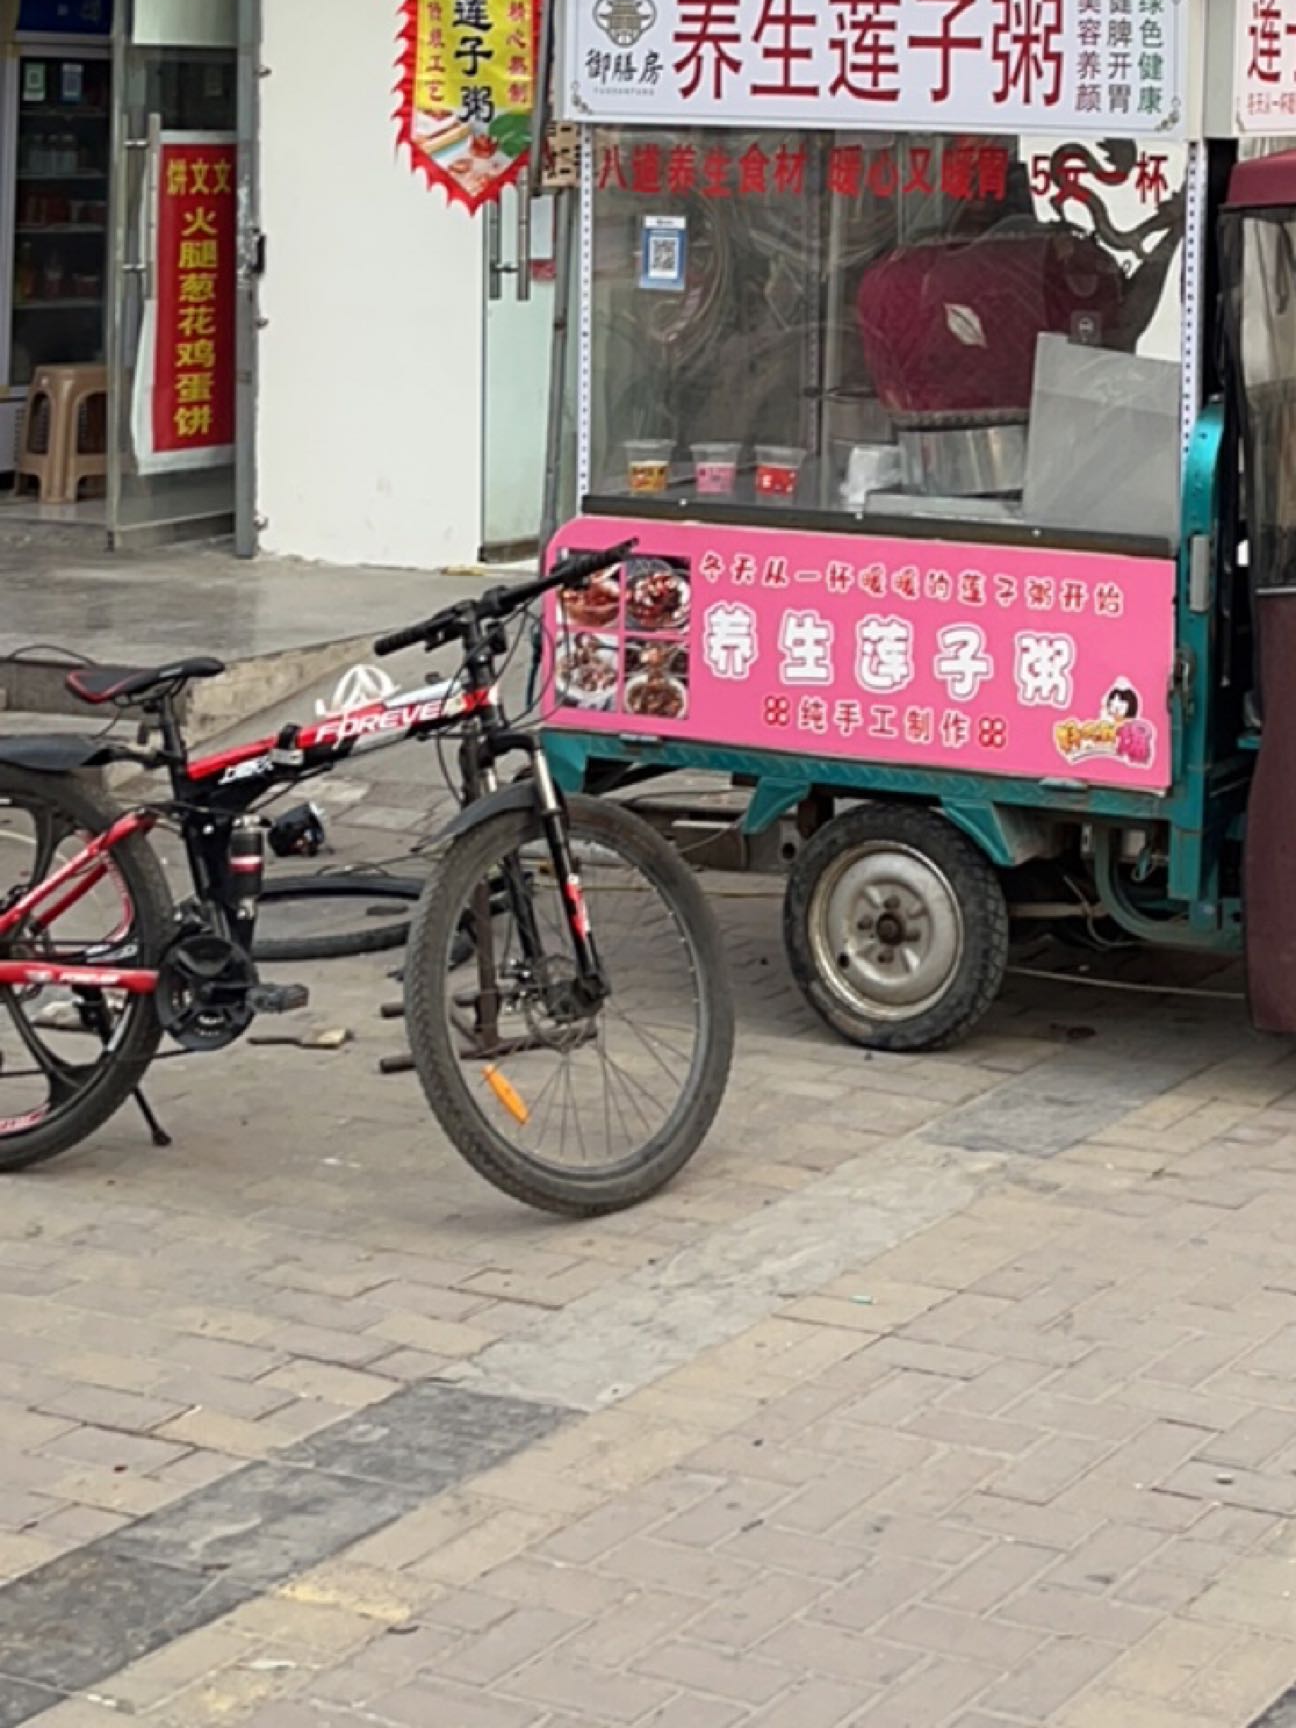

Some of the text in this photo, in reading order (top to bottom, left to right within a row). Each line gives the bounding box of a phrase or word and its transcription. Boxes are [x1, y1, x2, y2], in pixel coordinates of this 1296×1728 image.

[173, 206, 218, 437] 火腿葱花鸡蛋饼
[702, 553, 1122, 616] 冬天从一杯暖暖的莲子粥开始
[705, 604, 1073, 707] 养生莲子粥
[314, 701, 453, 745] FOREVE
[799, 696, 970, 748] 纯手工制作
